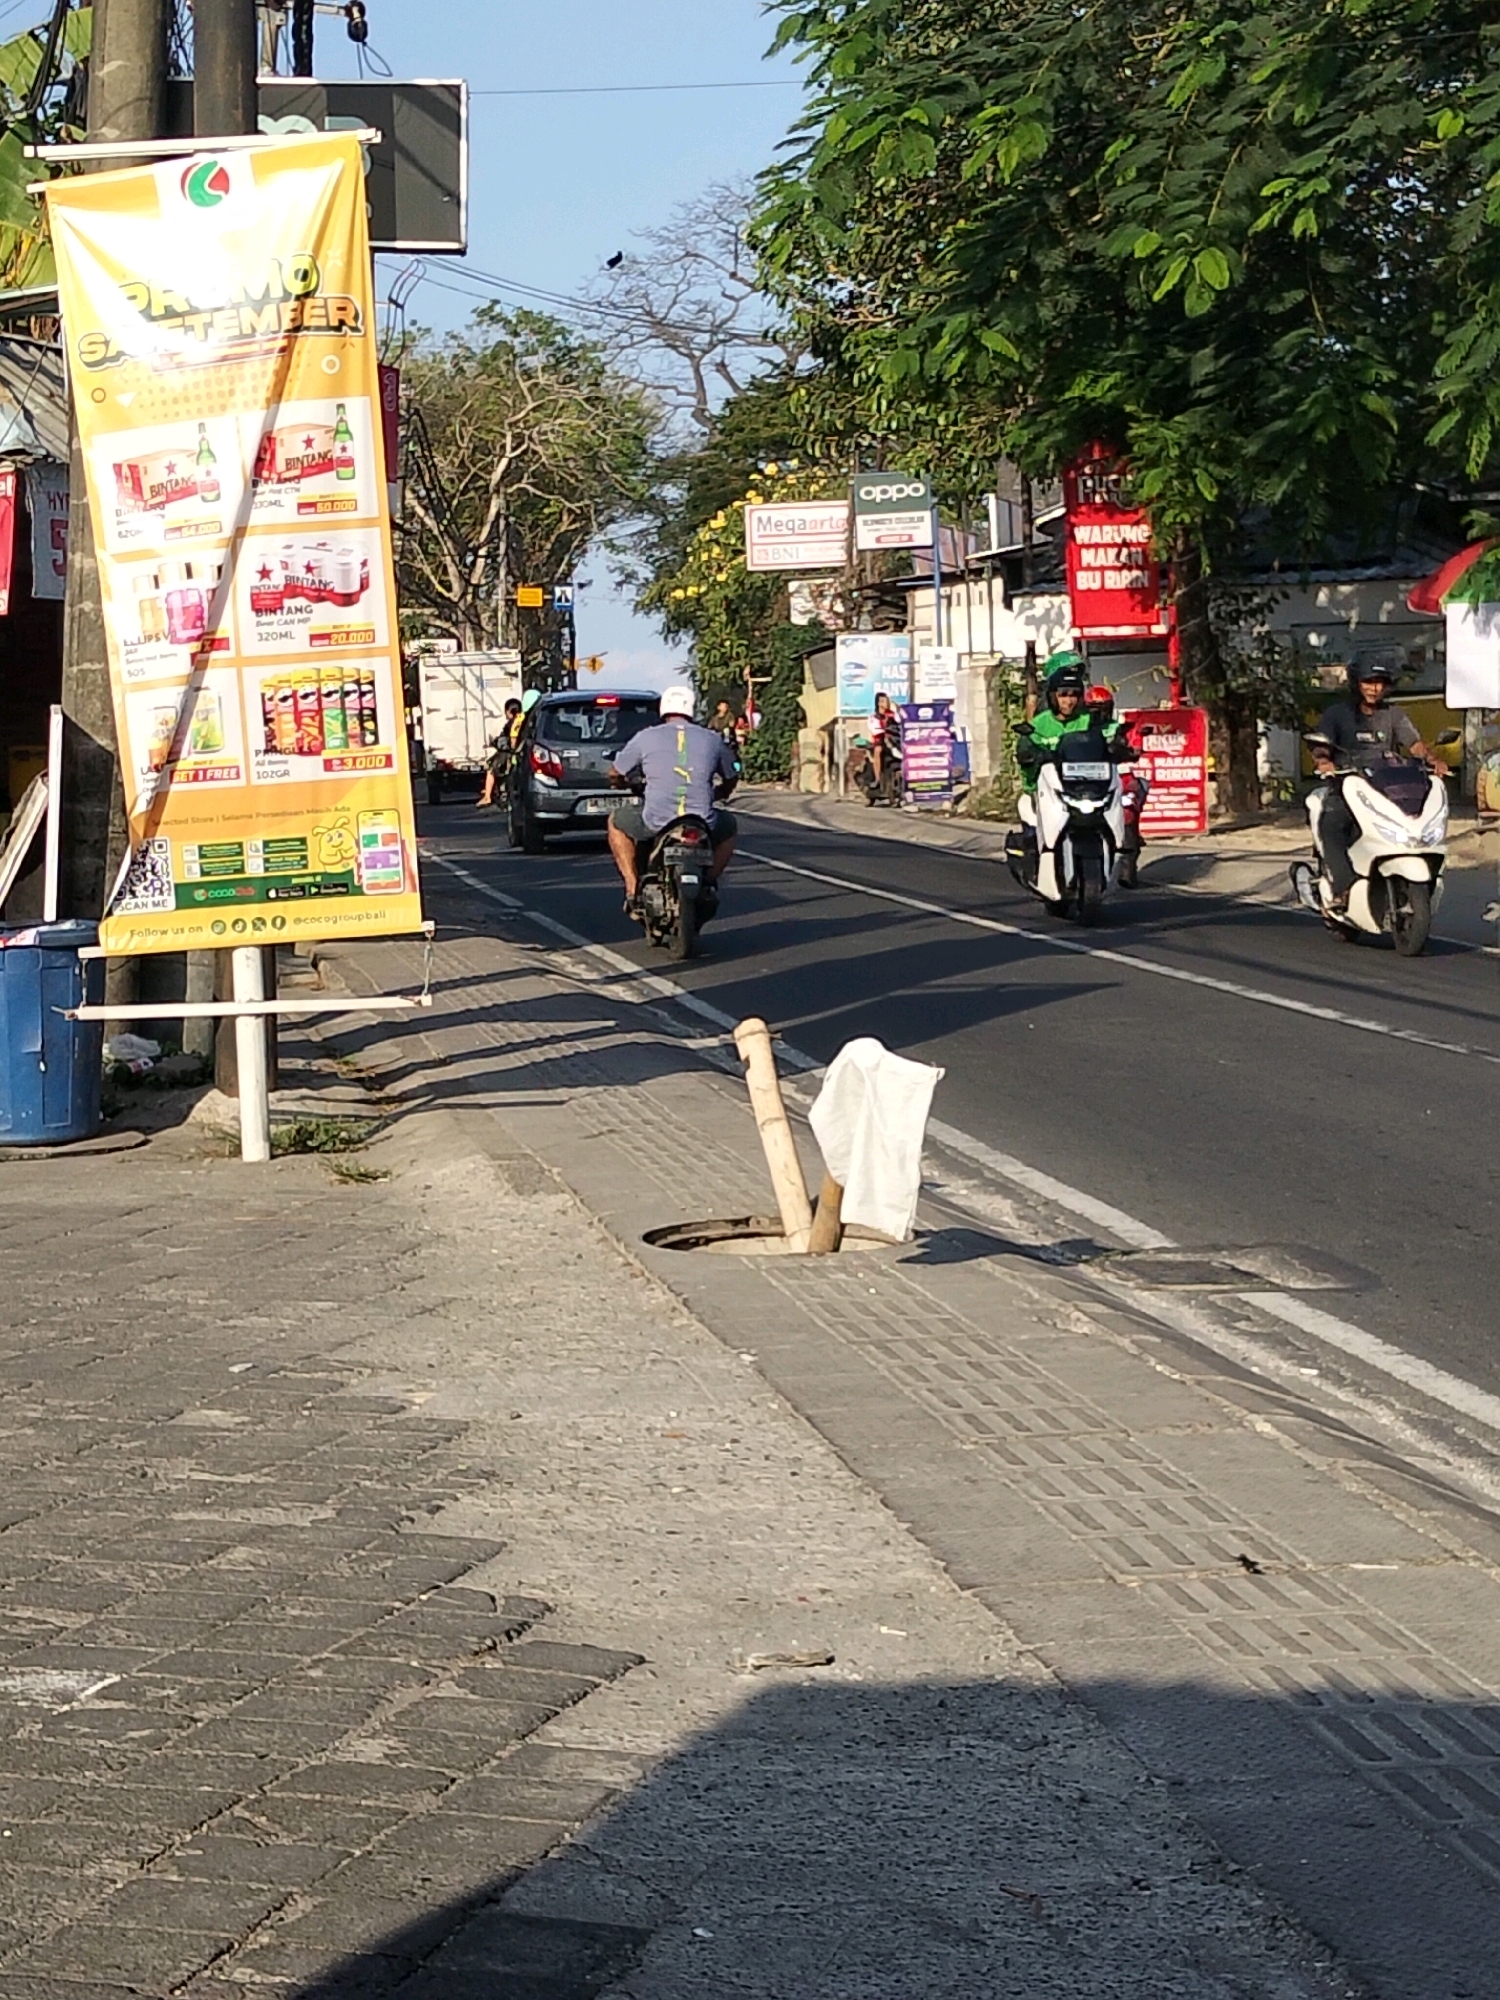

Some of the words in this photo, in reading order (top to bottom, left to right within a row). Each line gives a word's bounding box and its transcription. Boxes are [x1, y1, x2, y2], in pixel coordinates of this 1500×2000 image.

[285, 449, 334, 471] BINTANG
[1073, 524, 1151, 545] WARUNG
[771, 546, 800, 561] BNI
[1080, 547, 1144, 568] MAKAN
[1075, 571, 1101, 590] BU
[255, 604, 314, 618] BINTANG
[256, 630, 296, 643] 320ML
[330, 631, 374, 646] 20.000
[342, 755, 387, 770] 3.000
[172, 770, 197, 784] GET
[206, 768, 238, 781] FREE
[152, 899, 169, 909] ME
[293, 909, 387, 926] @cocogroupbali
[130, 928, 168, 938] Follow
[171, 926, 185, 934] us
[188, 926, 204, 934] on
